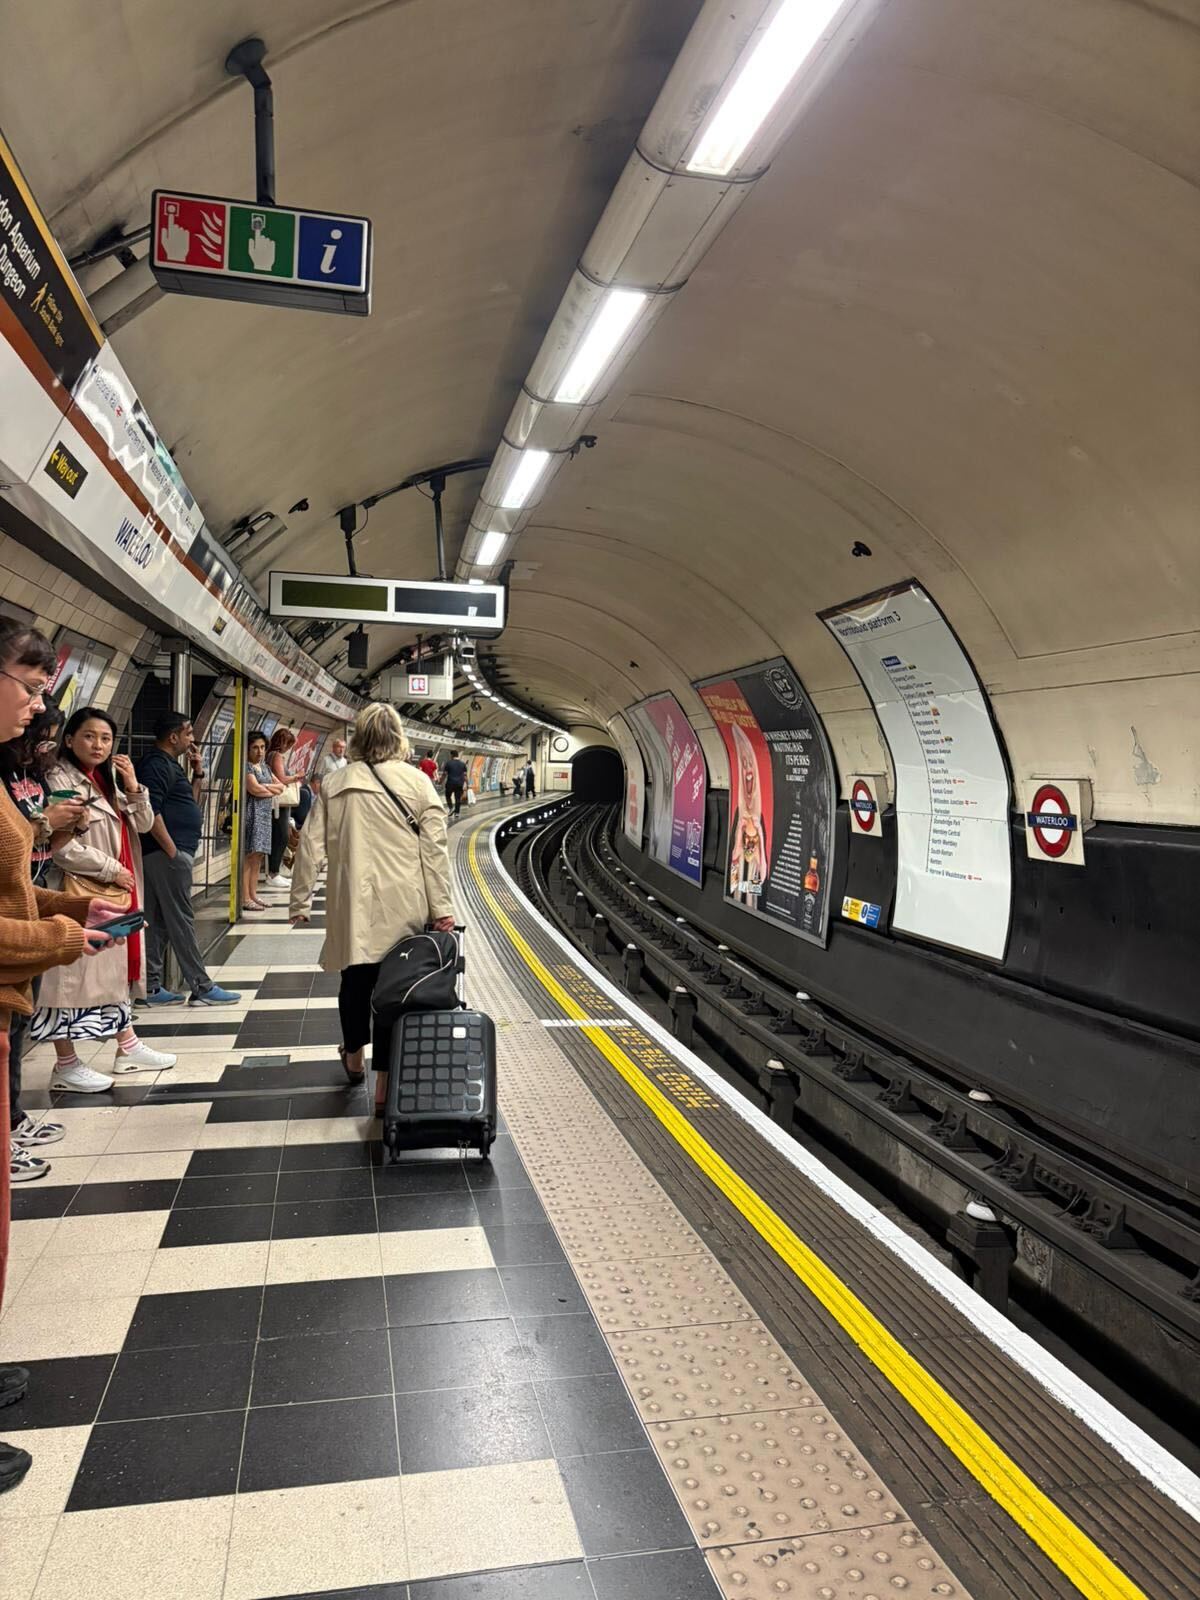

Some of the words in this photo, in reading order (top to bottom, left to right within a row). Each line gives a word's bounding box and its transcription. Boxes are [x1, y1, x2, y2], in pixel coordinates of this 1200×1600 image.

[0, 195, 13, 230] don
[8, 220, 41, 280] Aquarium
[0, 243, 27, 299] Dungeon
[39, 304, 50, 325] South
[56, 453, 69, 479] Way
[66, 469, 79, 486] out
[115, 517, 155, 570] WATERLOO
[837, 622, 868, 637] Northbound
[868, 615, 895, 632] platform
[893, 611, 901, 621] 3
[785, 755, 793, 765] ITS
[793, 755, 810, 766] PERKS
[855, 801, 873, 810] WATERLOO
[1036, 816, 1068, 826] WATERLOO
